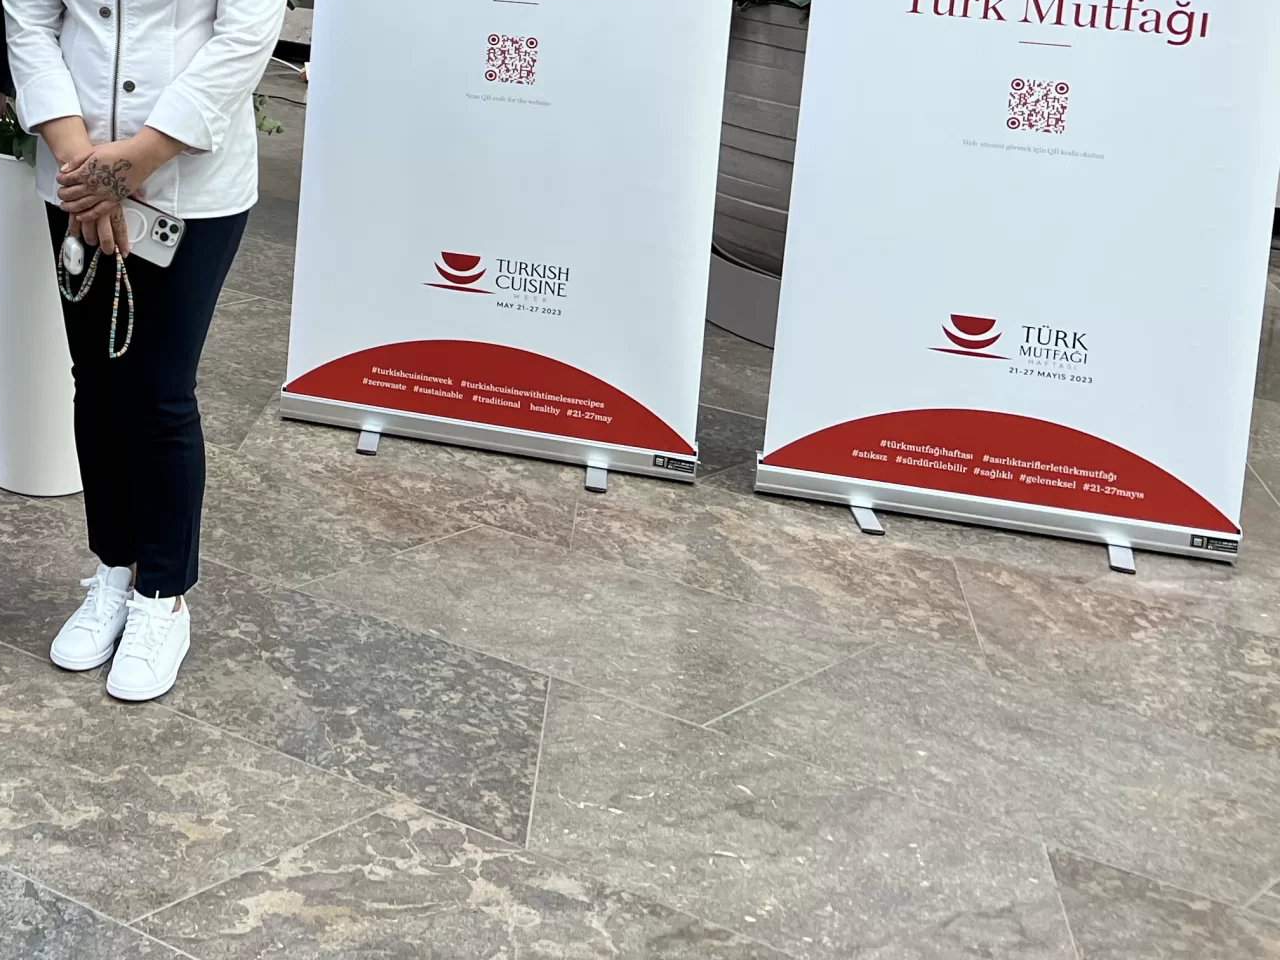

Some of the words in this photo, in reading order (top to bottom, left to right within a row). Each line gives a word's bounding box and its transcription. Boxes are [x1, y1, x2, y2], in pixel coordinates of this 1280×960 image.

[481, 94, 491, 102] QR
[980, 141, 1005, 150] sitesini
[1006, 144, 1032, 152] görmek
[1033, 146, 1046, 154] için
[1047, 147, 1060, 156] QR
[496, 258, 570, 281] TURKISH
[495, 275, 567, 297] CUISINE
[496, 301, 514, 310] MAY
[517, 304, 539, 313] 21-27
[541, 307, 562, 316] 2023
[1022, 325, 1088, 351] TÜRK
[1019, 345, 1088, 365] MUTFAĞI
[1009, 367, 1034, 377] 21-27
[1037, 370, 1066, 381] MAYIS
[1070, 374, 1093, 384] 2023
[371, 366, 453, 385] #turkishcuisineweek
[460, 380, 605, 409] #turkishcuisinewithtimelessrecipes
[362, 377, 407, 391] #zerowaste
[413, 385, 463, 400] #sustainable
[472, 394, 521, 409] #traditional
[529, 403, 561, 415] healthy
[566, 409, 612, 424] #21-27may
[880, 439, 973, 460] #türkmutfağıhaftası
[982, 454, 1118, 482] #asırlıktariflerletürkmutfağı
[851, 449, 888, 461] #atıksız
[895, 455, 968, 473] #sürdürülebilir
[973, 467, 1014, 480] #sağlıklı
[1019, 473, 1077, 489] #geleneksel
[1082, 483, 1145, 500] #21-27mayıs
